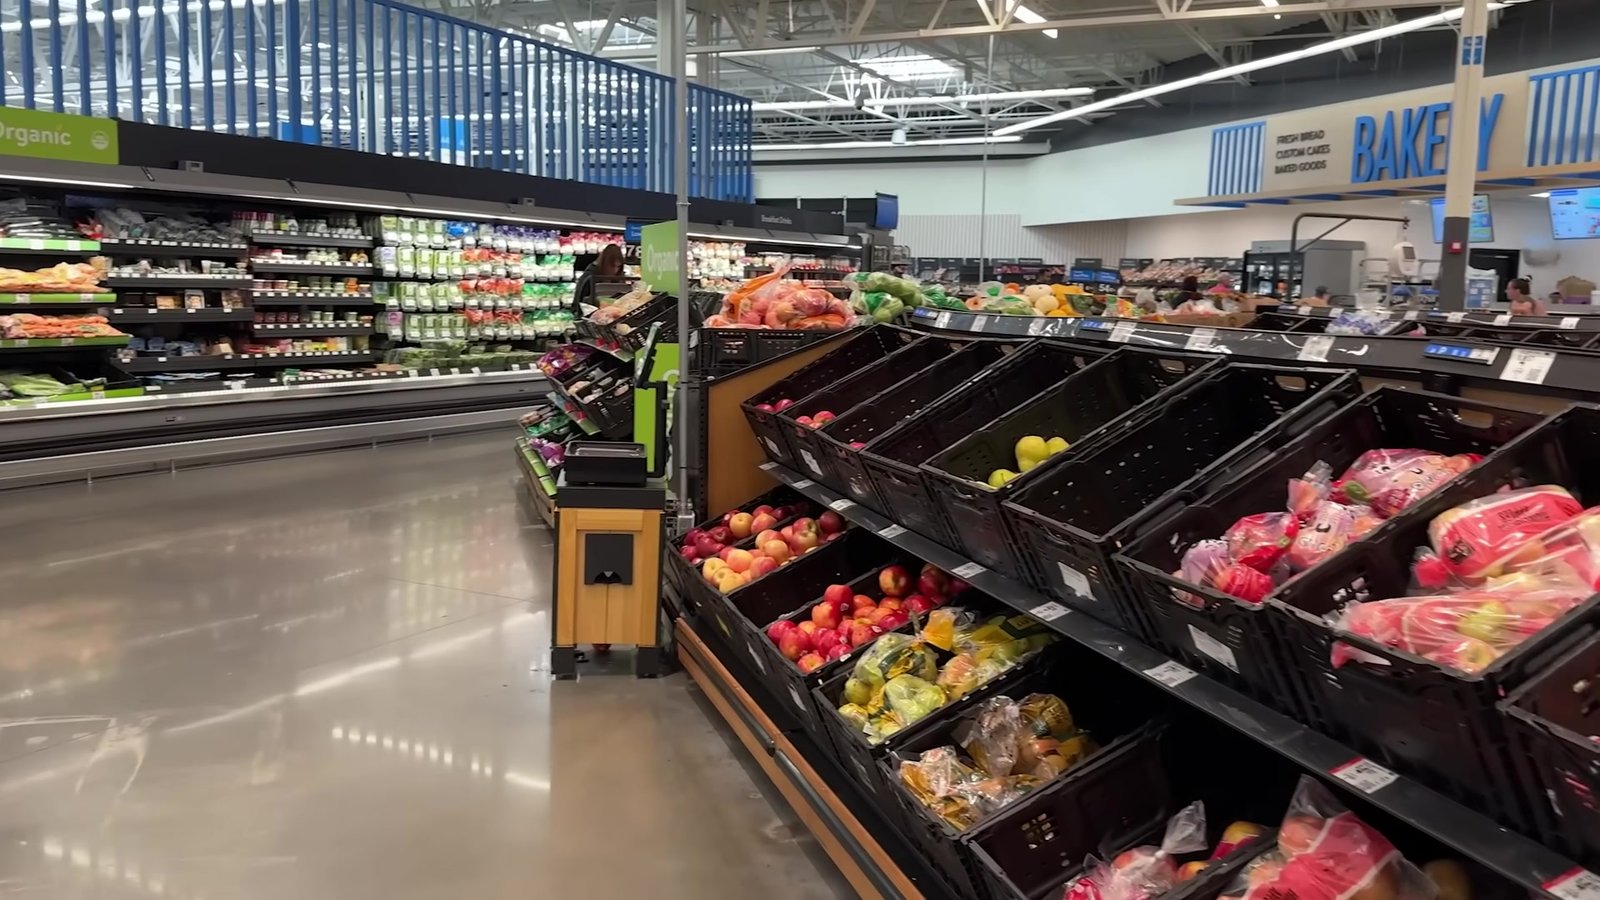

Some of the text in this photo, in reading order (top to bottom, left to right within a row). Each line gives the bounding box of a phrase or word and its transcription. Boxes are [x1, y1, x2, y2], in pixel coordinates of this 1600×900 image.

[1276, 130, 1325, 145] FRESH BREAD
[1351, 93, 1504, 183] BAKEY
[1275, 144, 1331, 160] CUSTOM CAKES
[1274, 160, 1327, 174] BAKED GOODS
